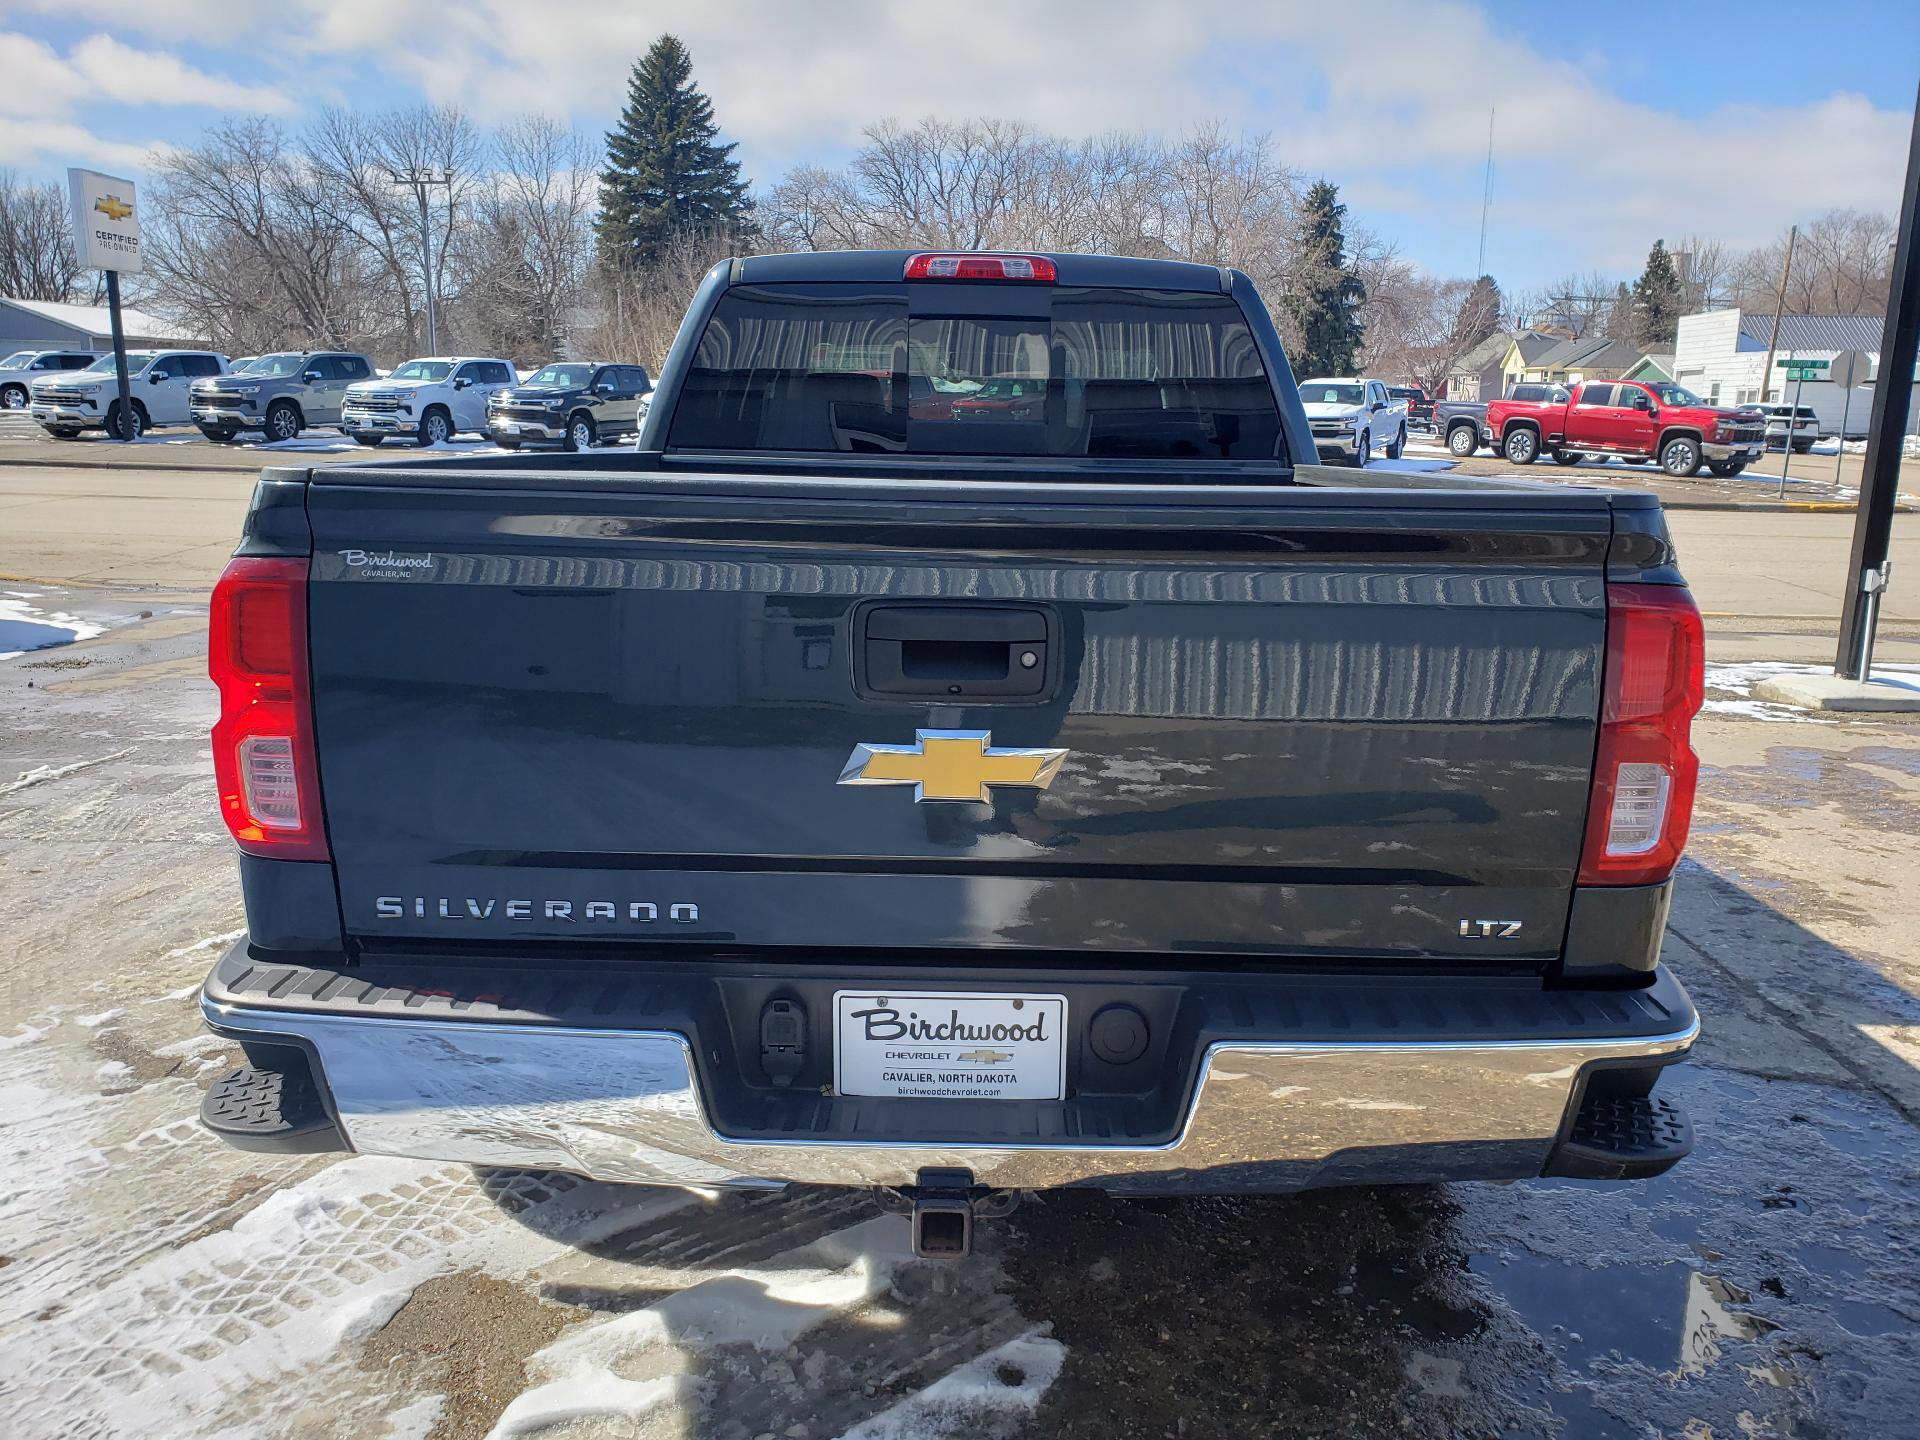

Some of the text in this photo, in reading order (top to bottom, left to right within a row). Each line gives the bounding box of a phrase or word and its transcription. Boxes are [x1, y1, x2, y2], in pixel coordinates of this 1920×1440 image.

[96, 230, 138, 245] CERTIFIED
[99, 240, 137, 253] PRE-OWNED
[338, 549, 434, 568] Birchwood
[376, 896, 699, 924] SILVERADO
[1459, 919, 1522, 940] LTZ
[851, 1008, 1049, 1042] Birchwood
[885, 1051, 951, 1061] CHEVROLET
[882, 1072, 1018, 1084] CAVALIER, NORTH DAKOTA
[897, 1087, 1002, 1097] birchwoodchevrolet.com
